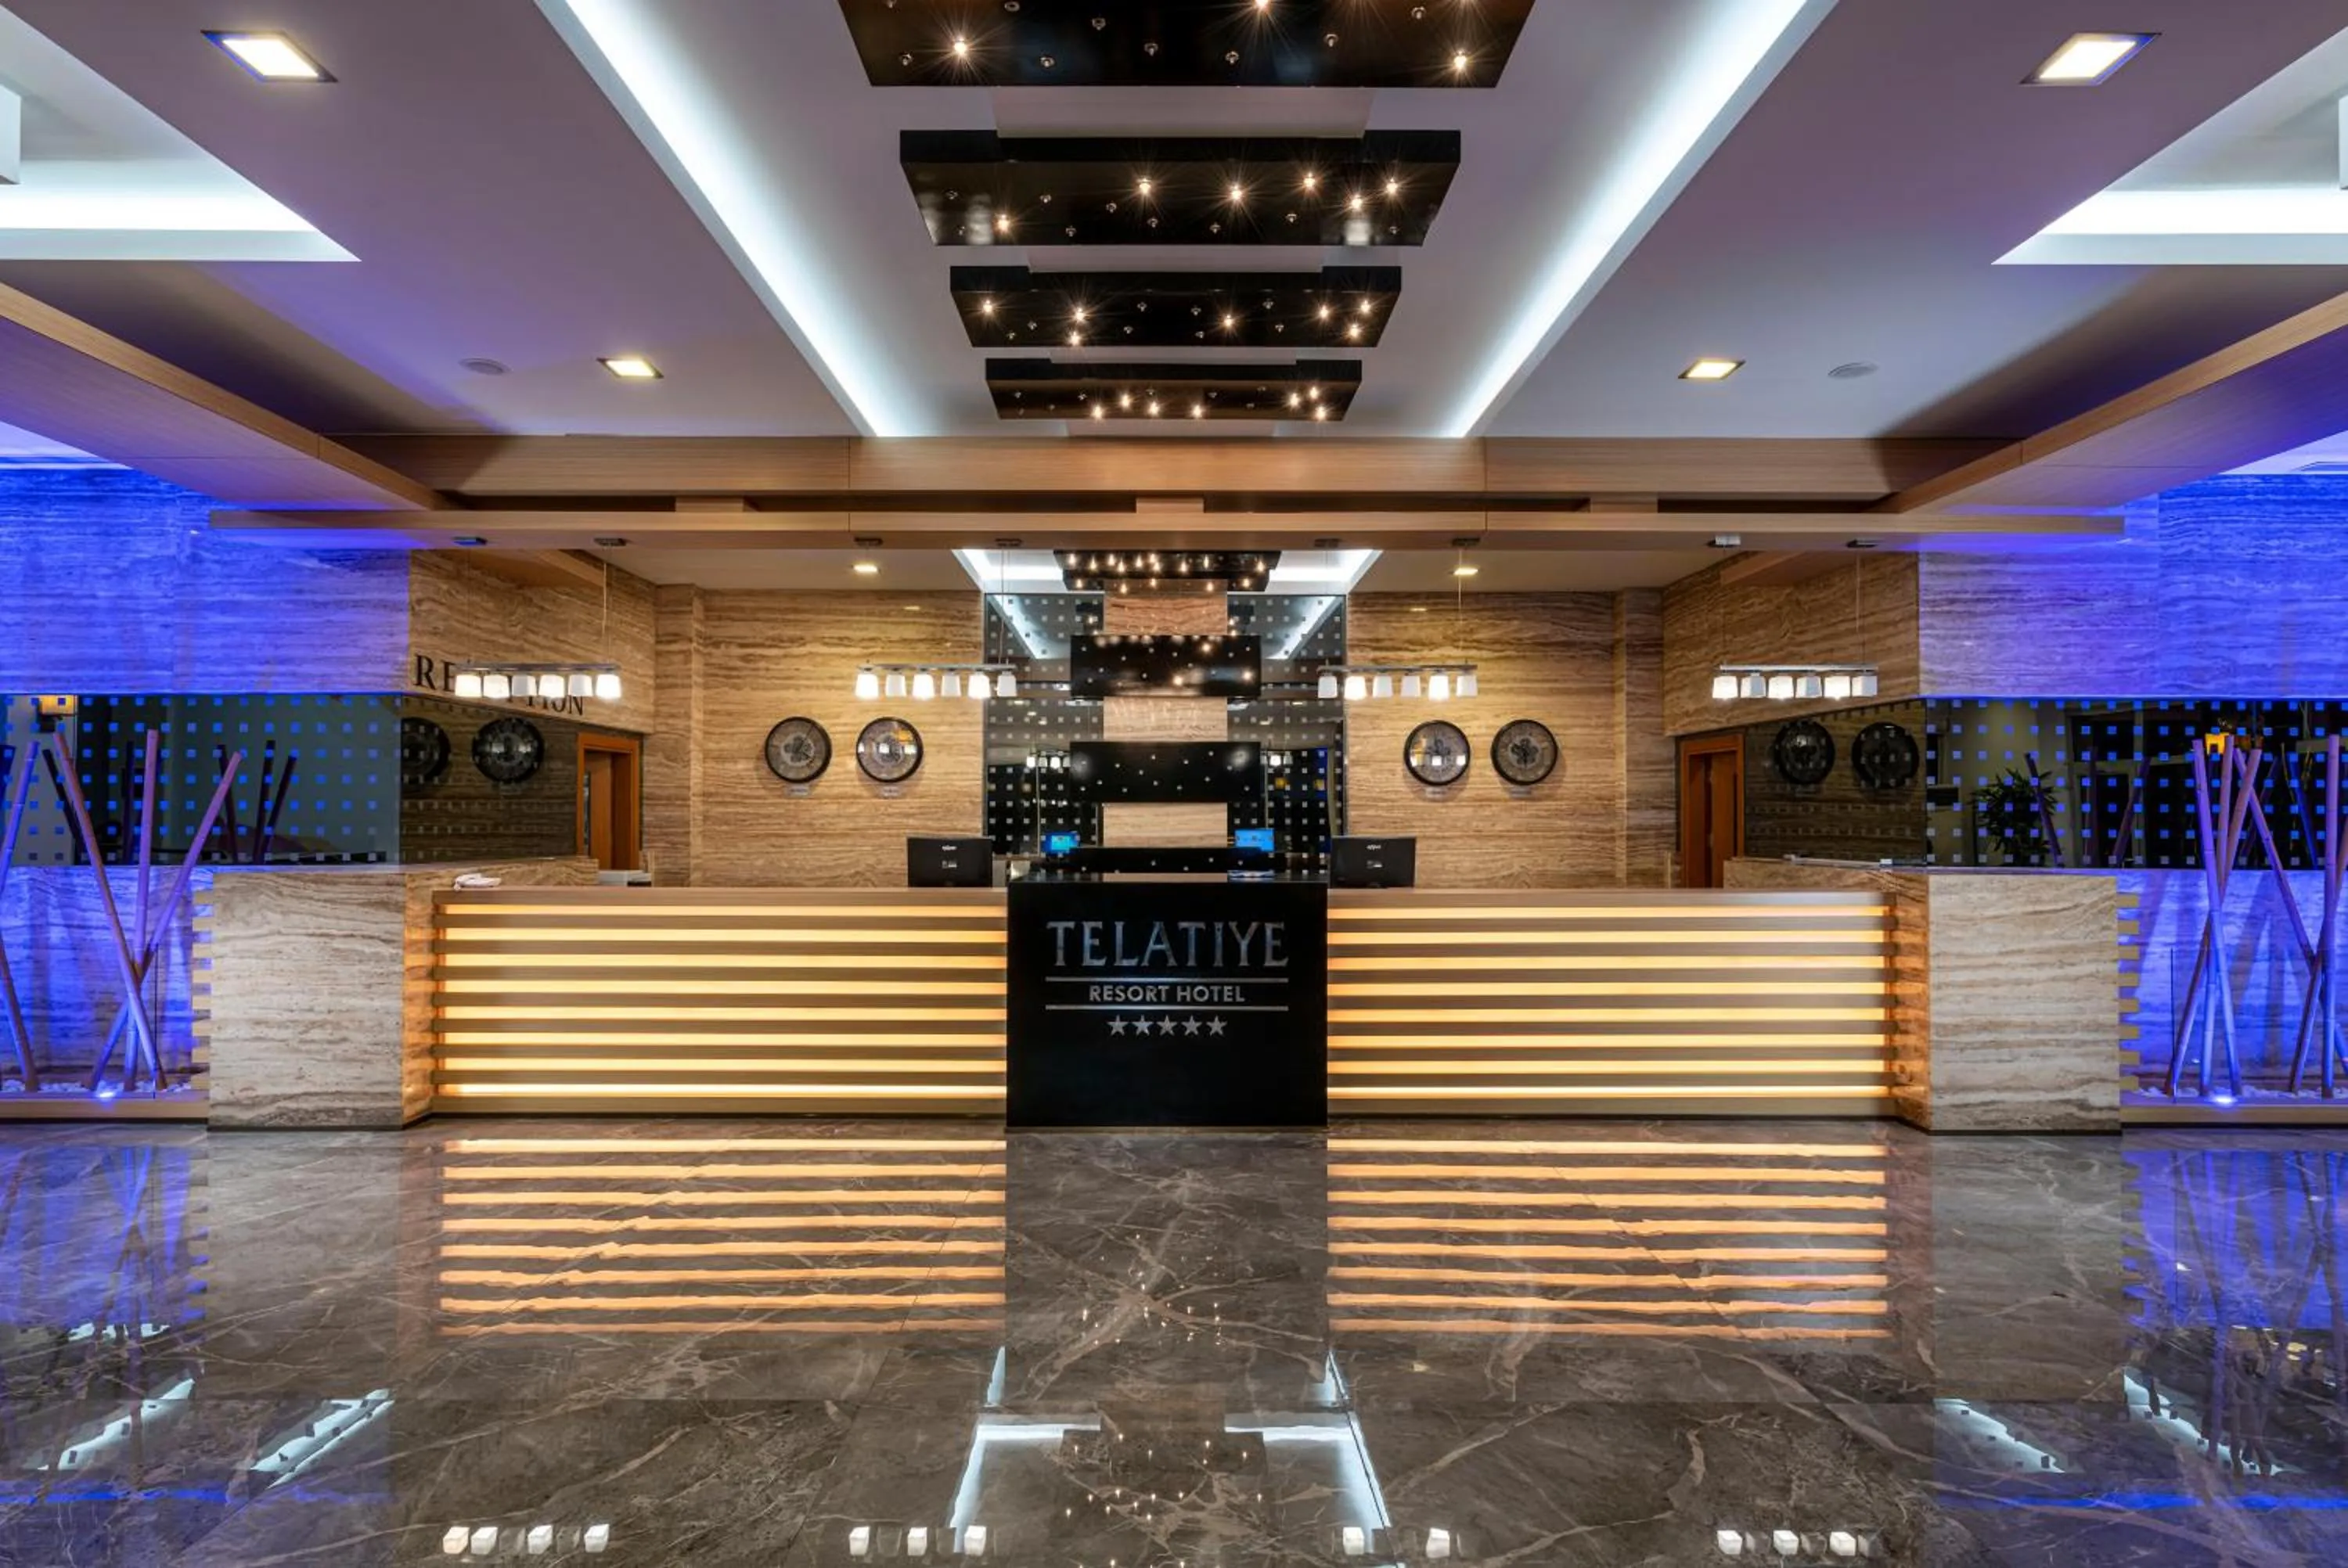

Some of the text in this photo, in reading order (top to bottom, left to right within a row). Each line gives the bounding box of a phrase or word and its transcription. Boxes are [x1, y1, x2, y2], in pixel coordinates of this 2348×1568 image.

[1046, 921, 1289, 967] TELATIYE
[1089, 985, 1244, 1002] RESORT HOTEL
